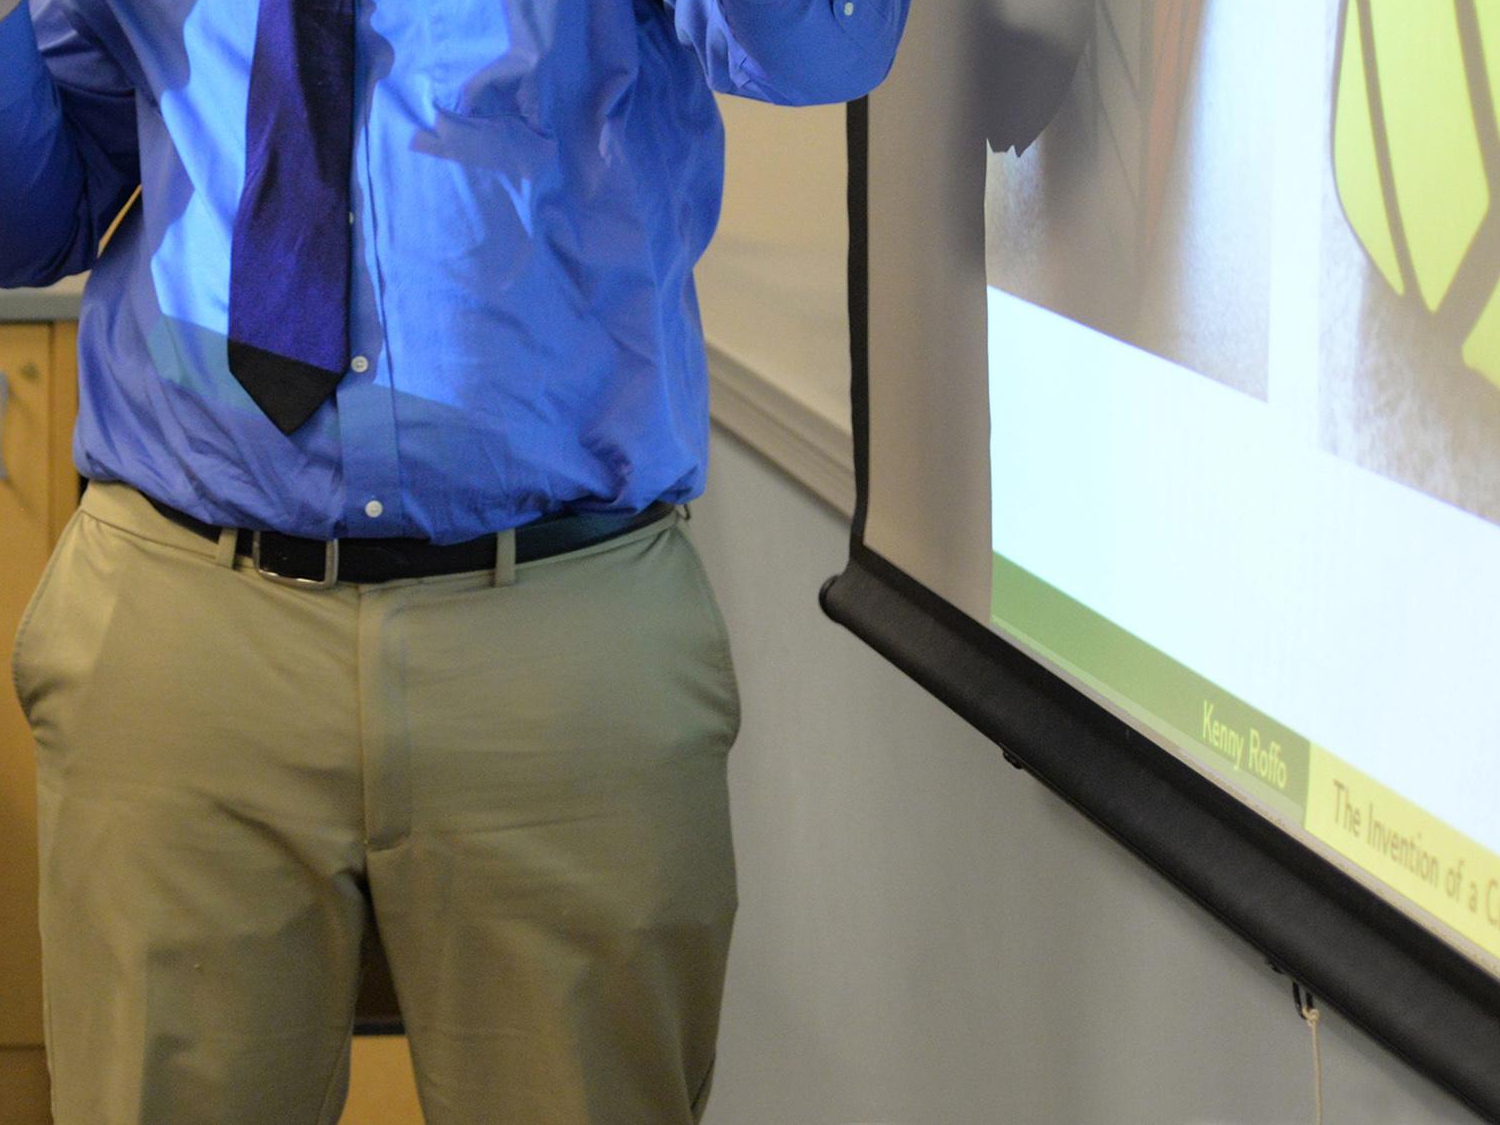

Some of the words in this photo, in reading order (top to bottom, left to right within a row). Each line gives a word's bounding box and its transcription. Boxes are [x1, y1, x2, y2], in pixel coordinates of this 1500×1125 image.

[1202, 698, 1245, 771] Kenny
[1248, 727, 1287, 789] Roffo
[1333, 778, 1361, 838] The
[1366, 802, 1439, 888] Invention
[1445, 858, 1465, 902] of
[1468, 881, 1478, 913] a
[1485, 877, 1500, 932] C
